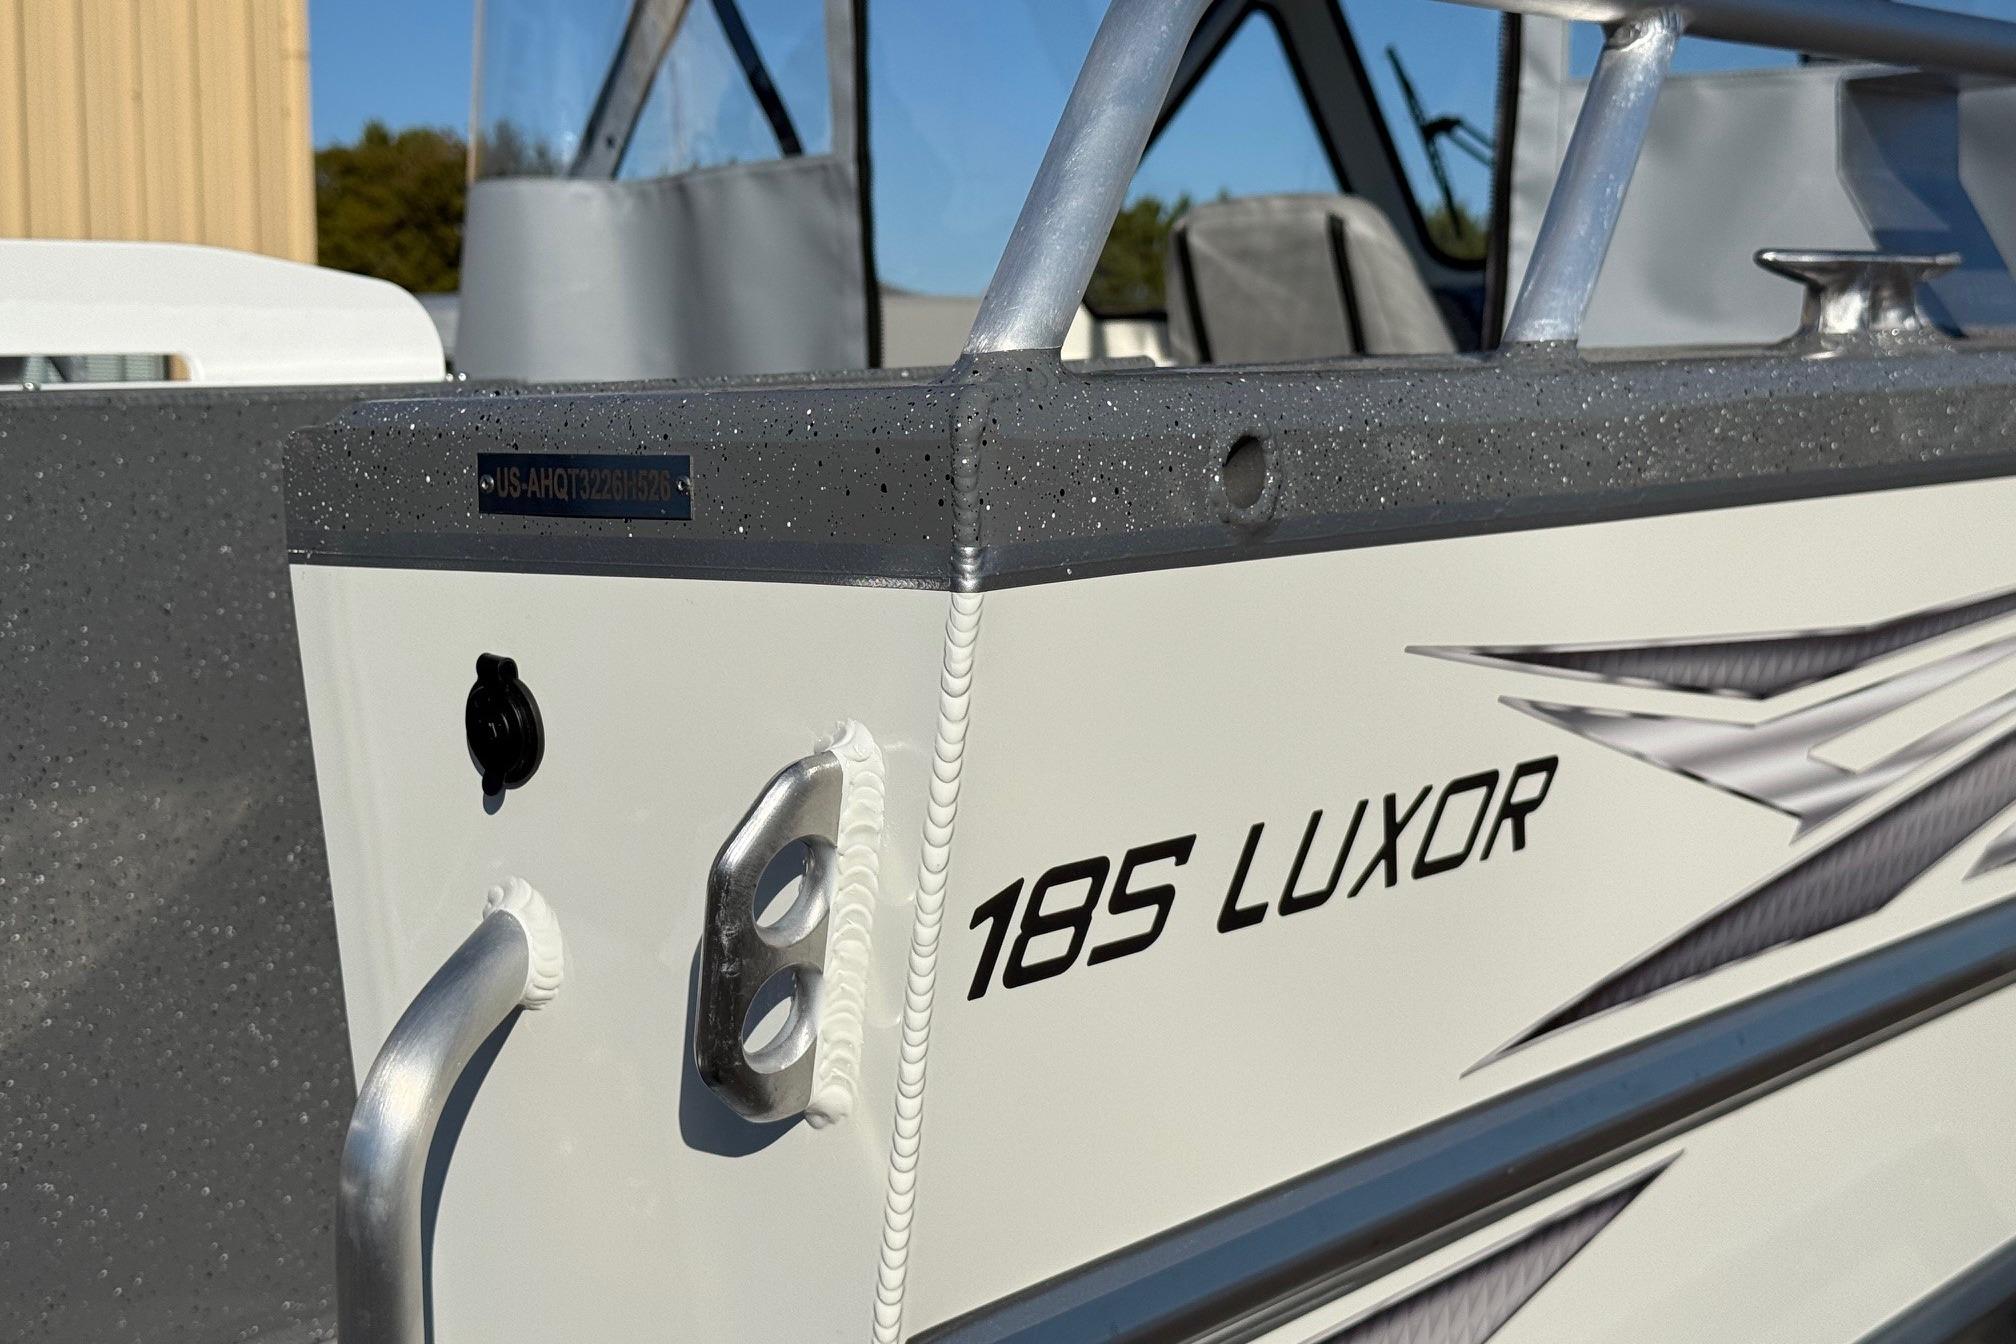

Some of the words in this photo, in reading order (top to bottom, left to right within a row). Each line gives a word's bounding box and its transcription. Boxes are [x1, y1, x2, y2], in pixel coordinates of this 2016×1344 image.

[496, 467, 671, 500] US-AHQT3226H526
[967, 834, 1196, 1001] 185
[1216, 755, 1559, 933] LUXOR
